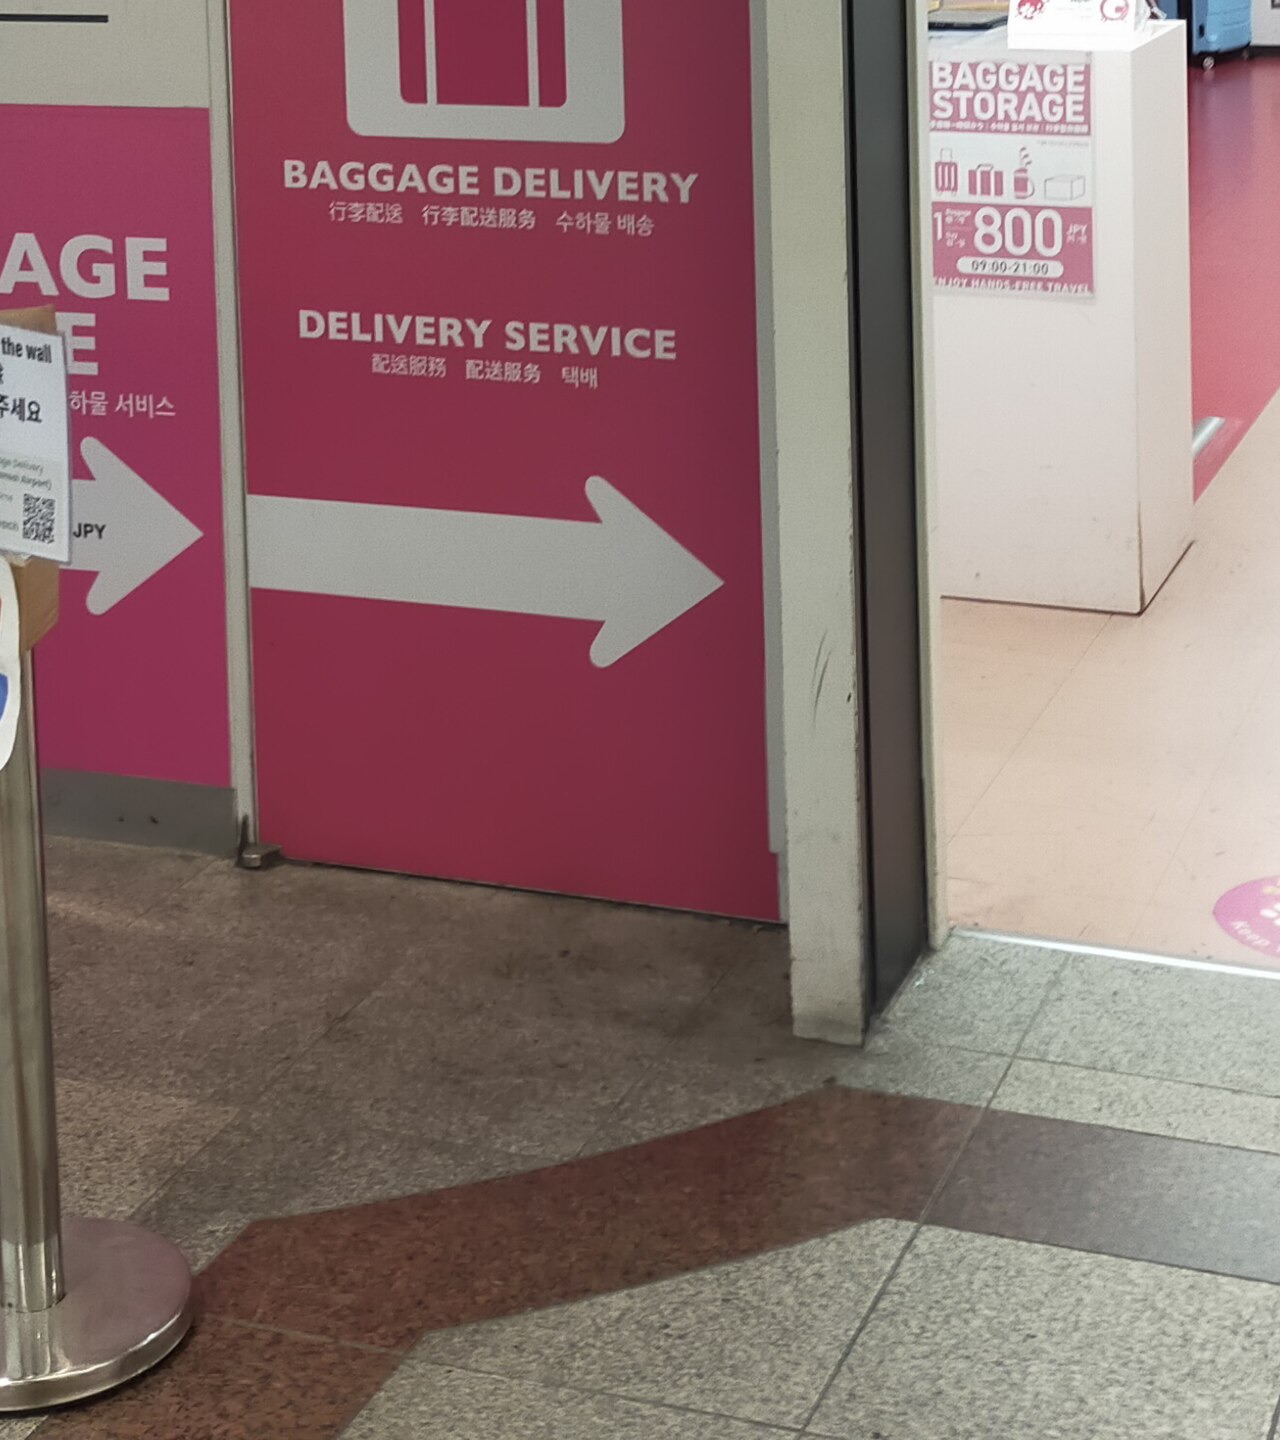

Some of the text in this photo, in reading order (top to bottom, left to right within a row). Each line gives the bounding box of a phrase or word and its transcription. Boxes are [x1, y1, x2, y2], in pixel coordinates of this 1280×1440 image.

[931, 61, 1086, 93] BAGGAGE
[932, 91, 1085, 123] STORAGE
[283, 160, 698, 203] BAGGAGE DELIVERY
[329, 201, 654, 237] 行李配送 行李配送服务 수하물 배송
[973, 206, 1062, 257] 800
[971, 260, 1049, 275] 09:00-21:00
[1, 336, 23, 357] the
[25, 344, 52, 363] wall
[298, 309, 677, 360] DELIVERY SERVICE
[465, 359, 541, 384] 配送服务
[562, 366, 598, 389] 택배
[115, 394, 176, 418] 서비스
[73, 523, 106, 539] JPY
